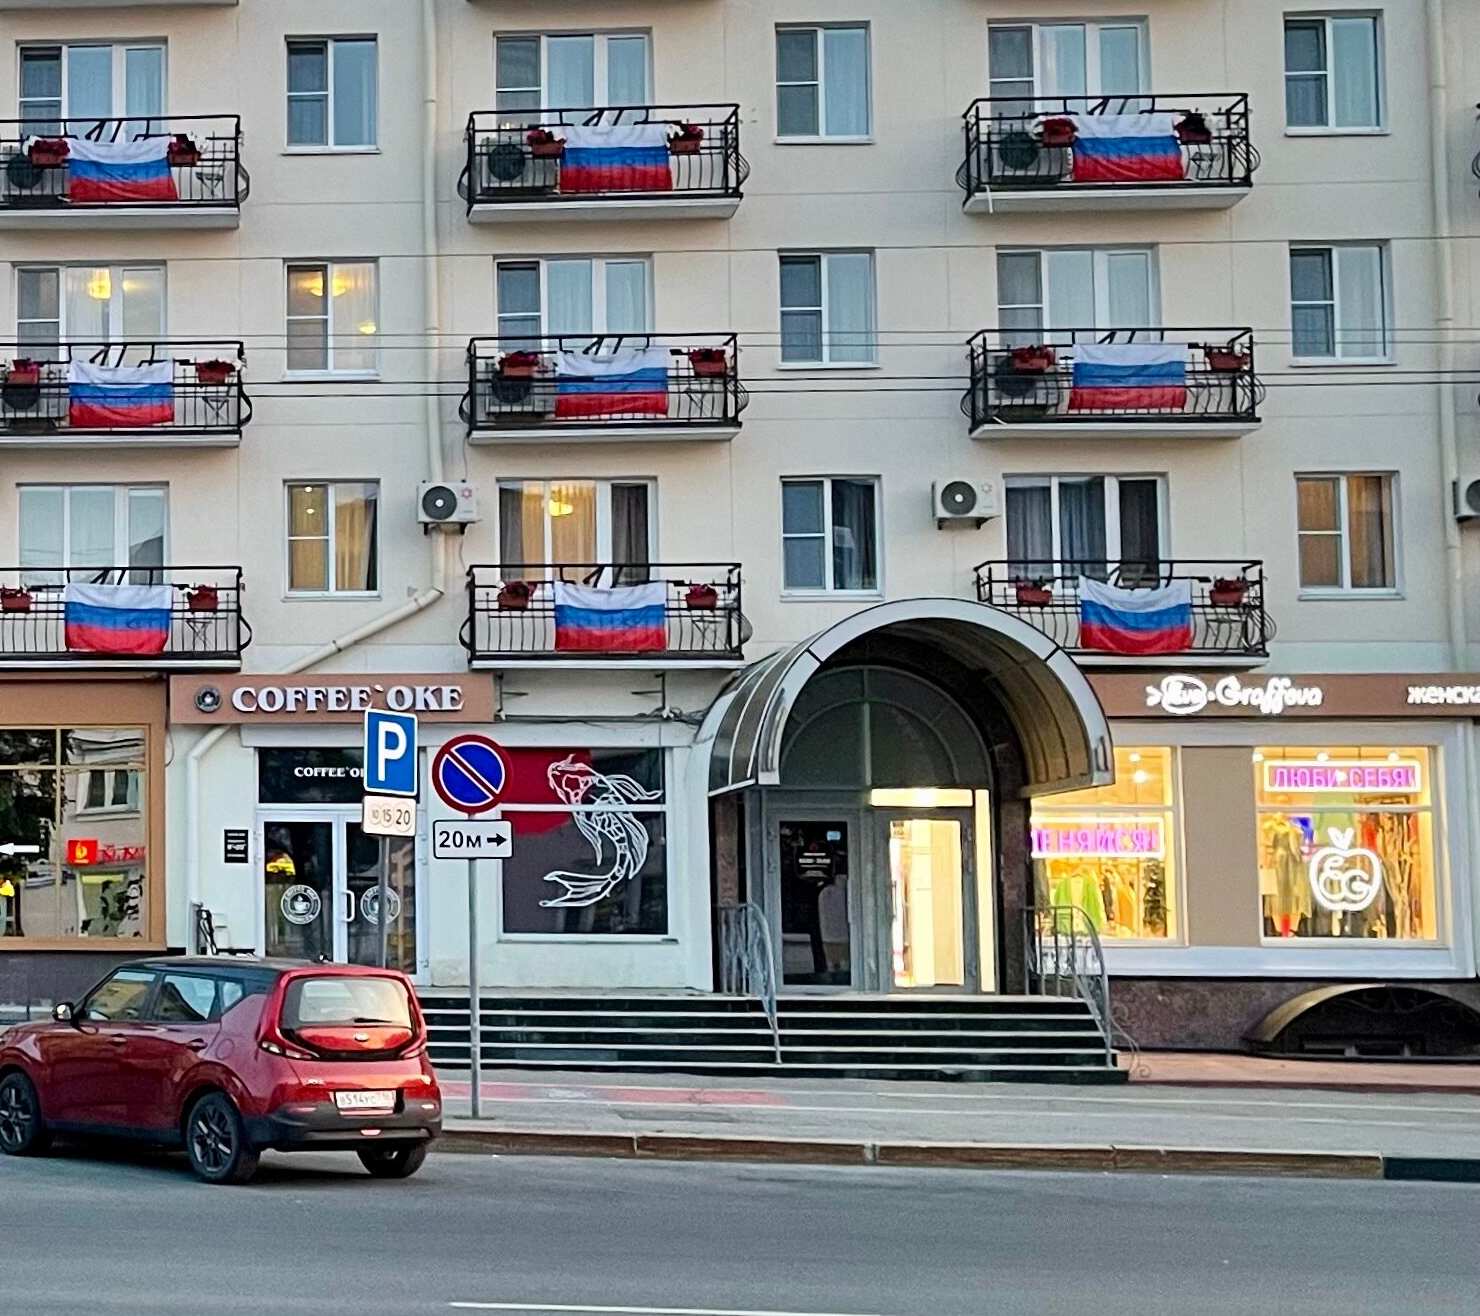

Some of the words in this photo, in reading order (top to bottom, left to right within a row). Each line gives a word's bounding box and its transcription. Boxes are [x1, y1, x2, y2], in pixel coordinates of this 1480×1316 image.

[377, 721, 408, 782] P
[1274, 767, 1339, 788] ЛЮБИ
[395, 808, 411, 826] 20
